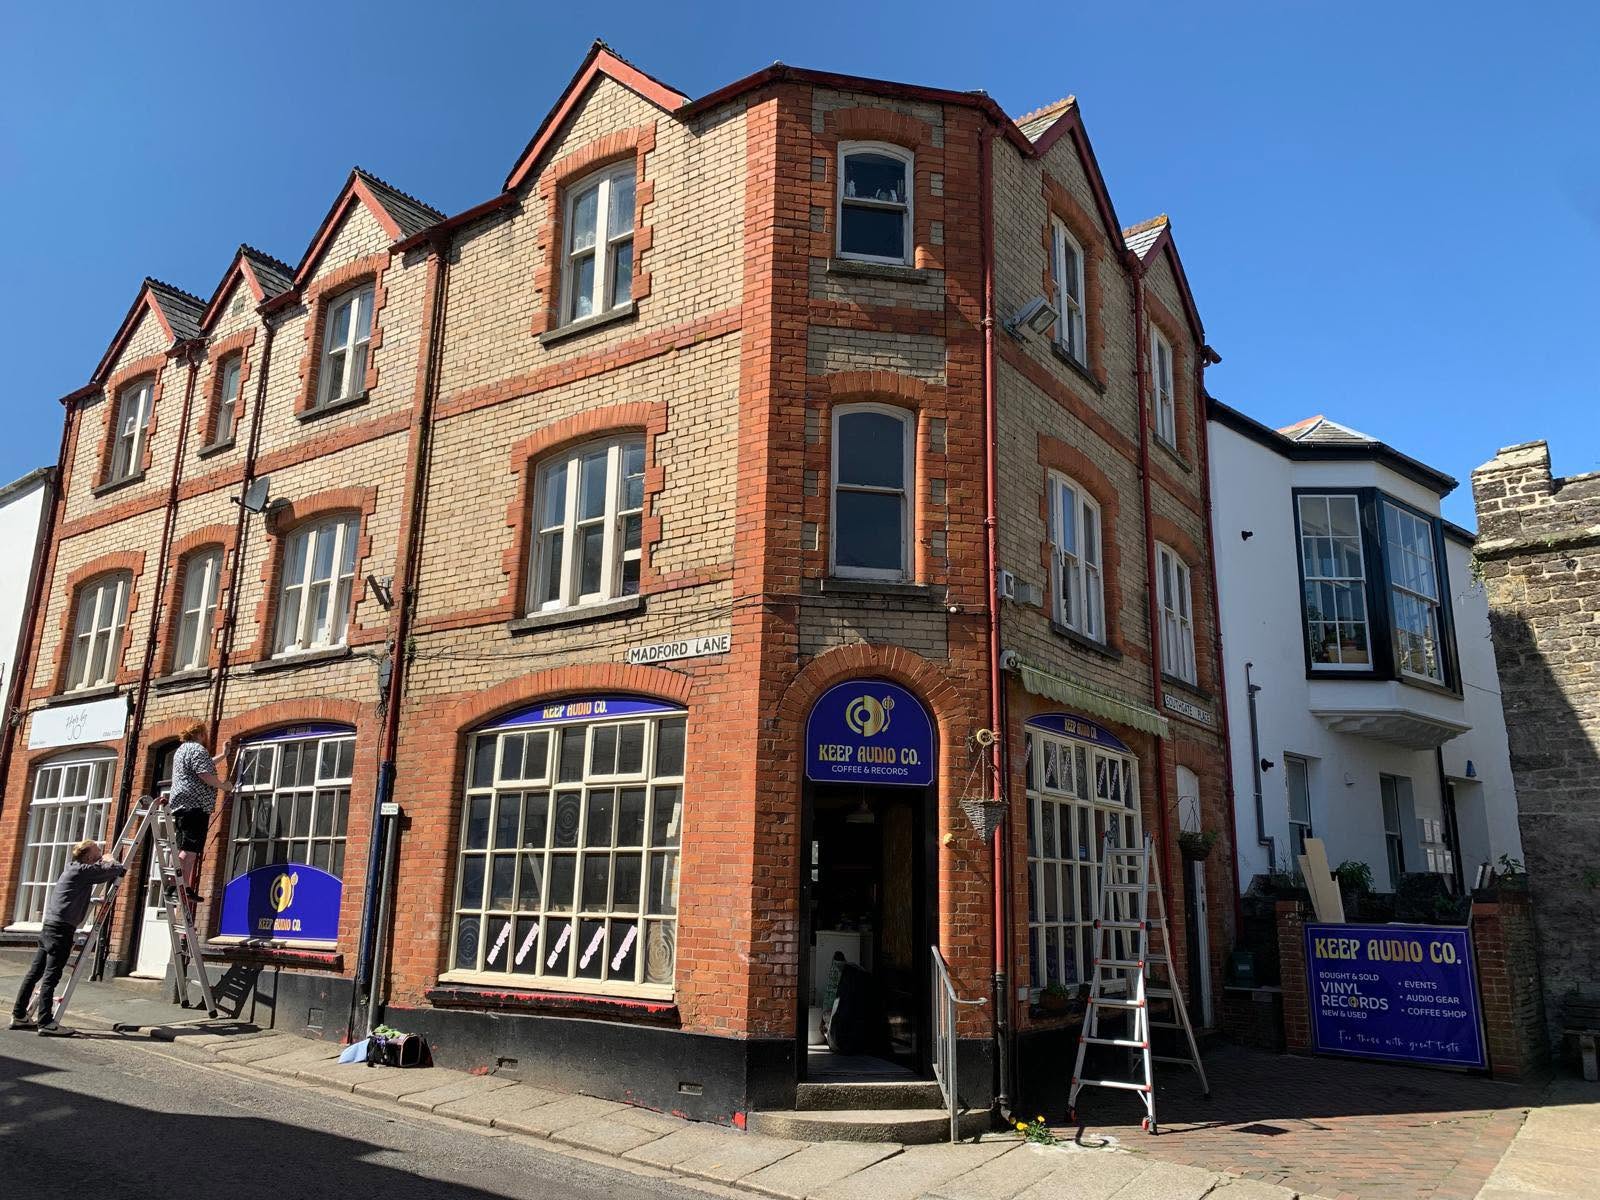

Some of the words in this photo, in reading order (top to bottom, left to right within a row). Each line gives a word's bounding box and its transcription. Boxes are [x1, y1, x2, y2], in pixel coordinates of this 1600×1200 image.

[631, 643, 688, 662] MADFORD
[696, 636, 728, 654] LANE
[543, 704, 565, 719] KEEP
[566, 702, 592, 716] AUDIO
[594, 700, 607, 713] CO.
[1166, 695, 1192, 716] SOUTHGATE
[819, 744, 853, 761] KEEP
[857, 746, 896, 763] AUDIO
[901, 748, 921, 765] CO.
[831, 765, 862, 773] COFFEE
[871, 766, 909, 775] RECORDS
[1315, 938, 1360, 960] KEEP
[1368, 940, 1423, 962] AUDIO
[1429, 942, 1462, 964] CO.
[1320, 972, 1350, 980] BOUGHT
[1320, 981, 1362, 995] VINYL
[1404, 981, 1437, 990] EVENTS
[1321, 995, 1389, 1010] RECORDS
[1406, 995, 1434, 1003] AUDIO
[1436, 996, 1460, 1004] GEAR
[1347, 1011, 1367, 1019] USED
[1408, 1007, 1440, 1017] COFFEE
[1442, 1010, 1467, 1018] SHOP
[1356, 1033, 1379, 1044] those
[1386, 1037, 1403, 1046] with
[1410, 1040, 1434, 1051] great
